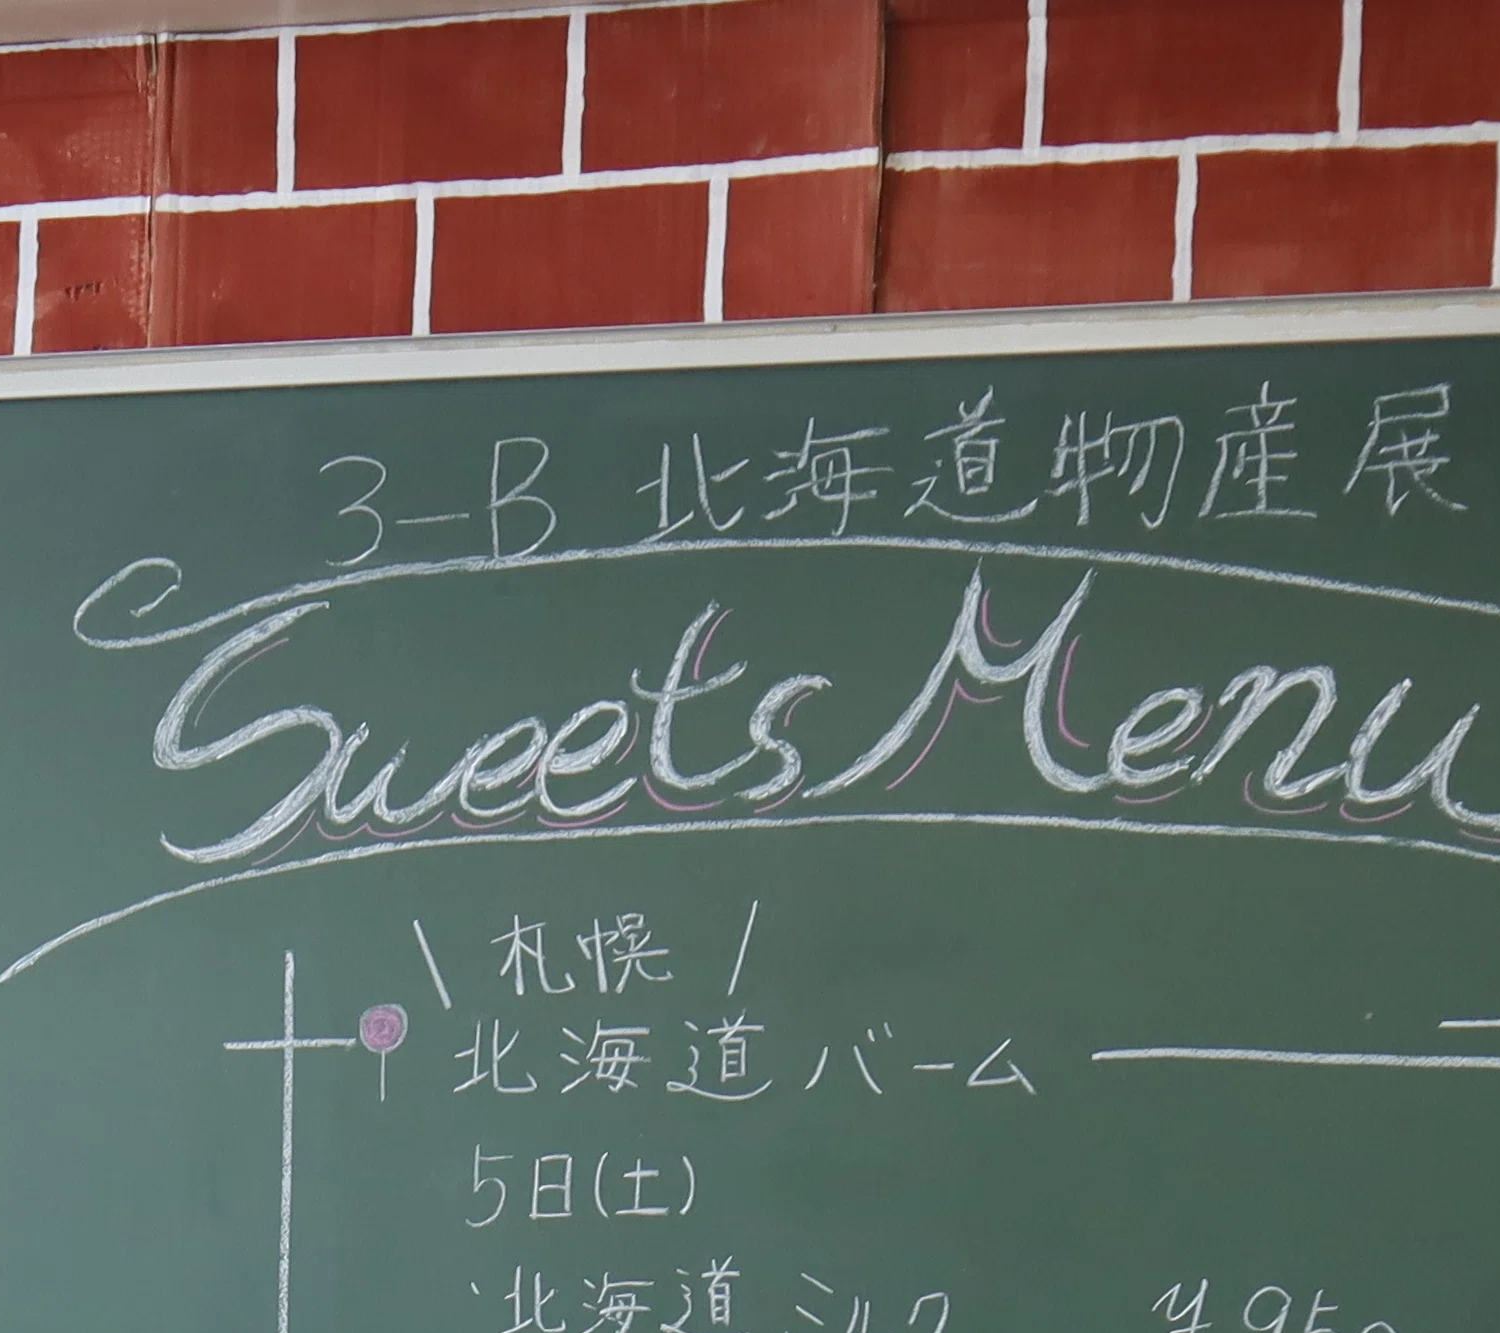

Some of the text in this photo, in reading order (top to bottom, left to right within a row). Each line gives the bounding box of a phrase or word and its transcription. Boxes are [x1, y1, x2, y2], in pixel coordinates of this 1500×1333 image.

[318, 380, 1468, 566] 3-B 北海道物産展
[153, 600, 832, 864] Sweets
[491, 913, 673, 996] 札幌
